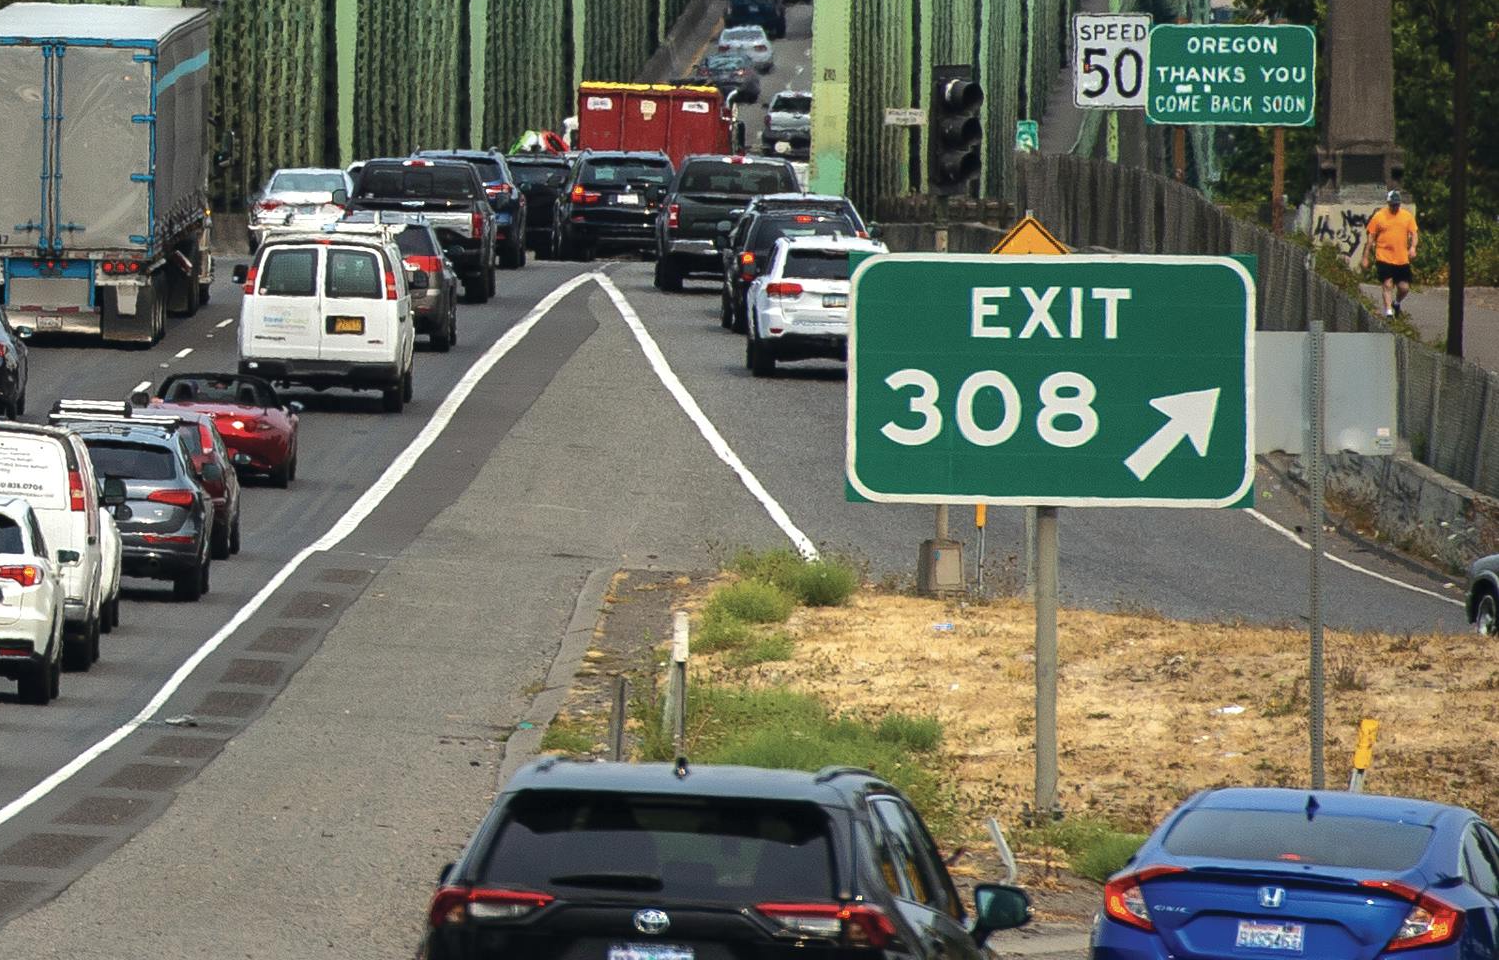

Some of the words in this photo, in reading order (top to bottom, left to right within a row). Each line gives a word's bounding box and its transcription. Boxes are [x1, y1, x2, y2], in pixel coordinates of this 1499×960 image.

[1080, 24, 1146, 41] SPEED
[1187, 37, 1278, 54] OREGON
[1083, 48, 1143, 99] 50
[1156, 66, 1246, 83] THANKS
[1260, 66, 1307, 83] YOU
[1155, 95, 1201, 112] COME
[1211, 95, 1253, 112] BACK
[1262, 95, 1306, 113] SOON
[971, 286, 1133, 339] EXIT
[880, 368, 1099, 448] 308
